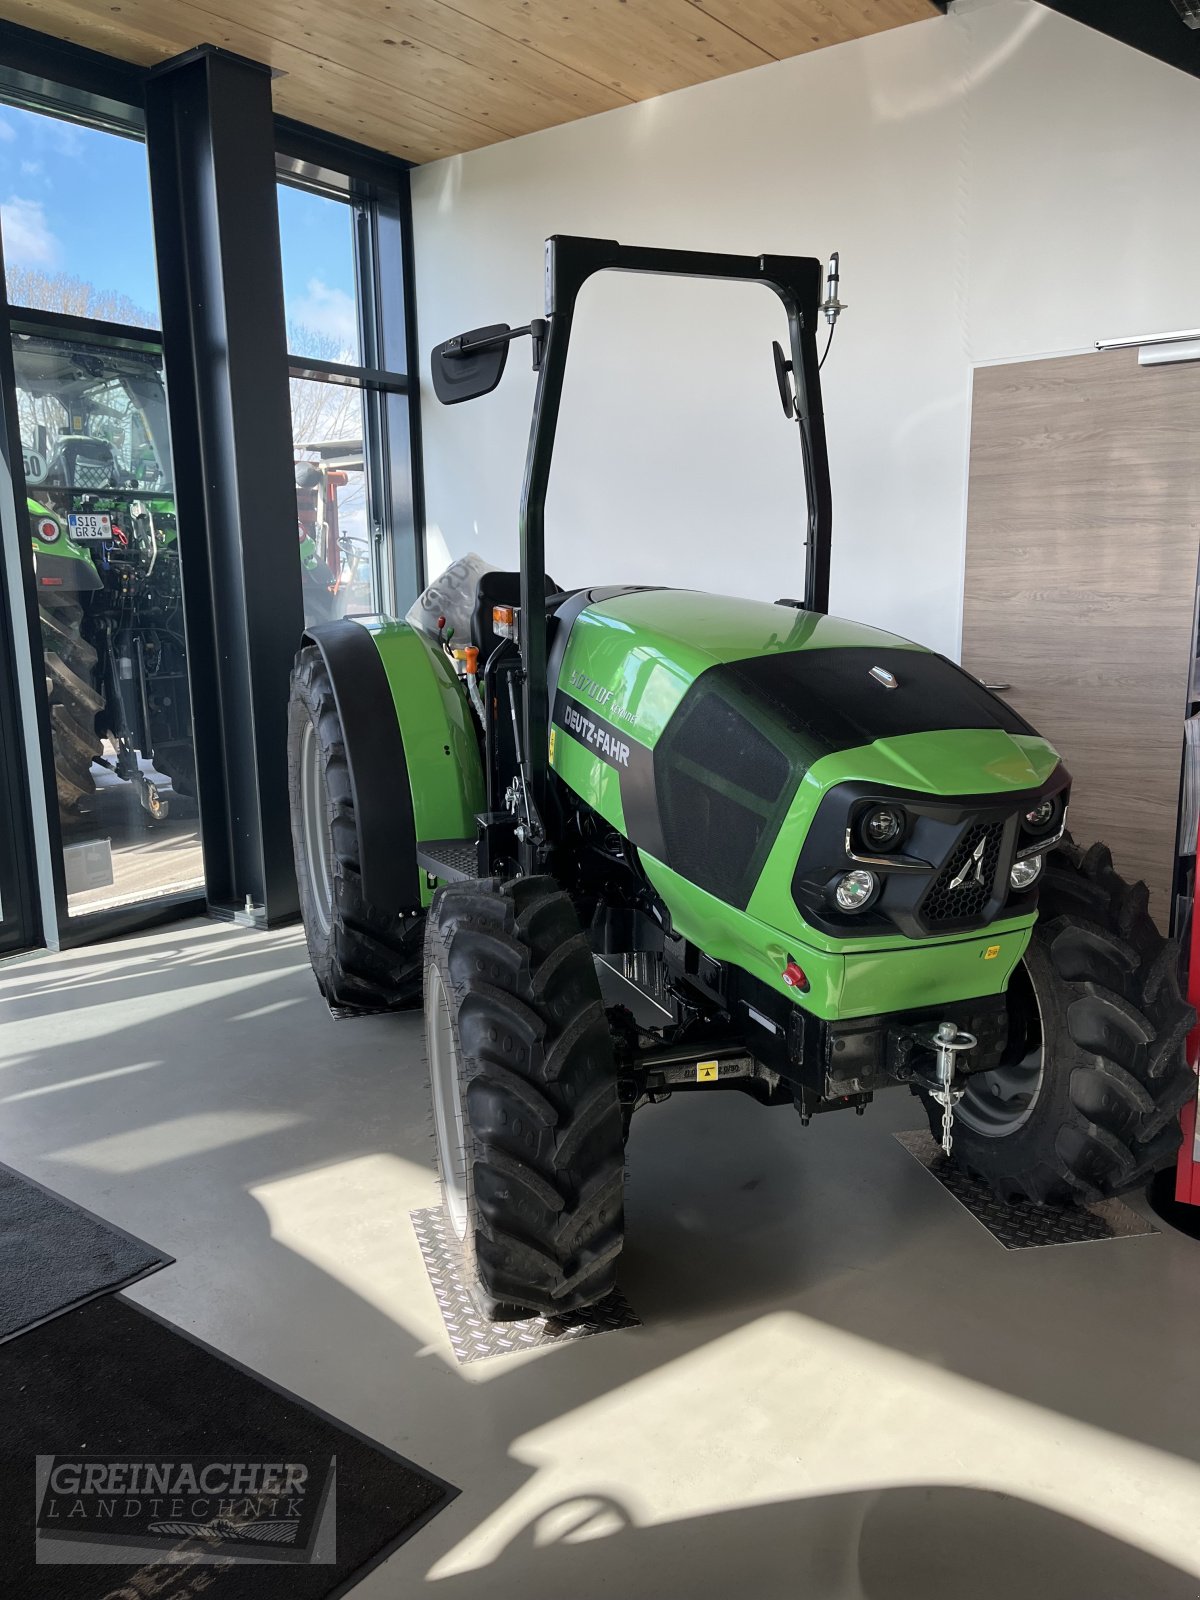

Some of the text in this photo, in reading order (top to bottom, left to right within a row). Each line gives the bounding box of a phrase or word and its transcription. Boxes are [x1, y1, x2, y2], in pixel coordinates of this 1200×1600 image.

[77, 516, 97, 527] SIG
[75, 527, 103, 537] GR 34
[564, 705, 630, 768] DEUTZ-FAHR
